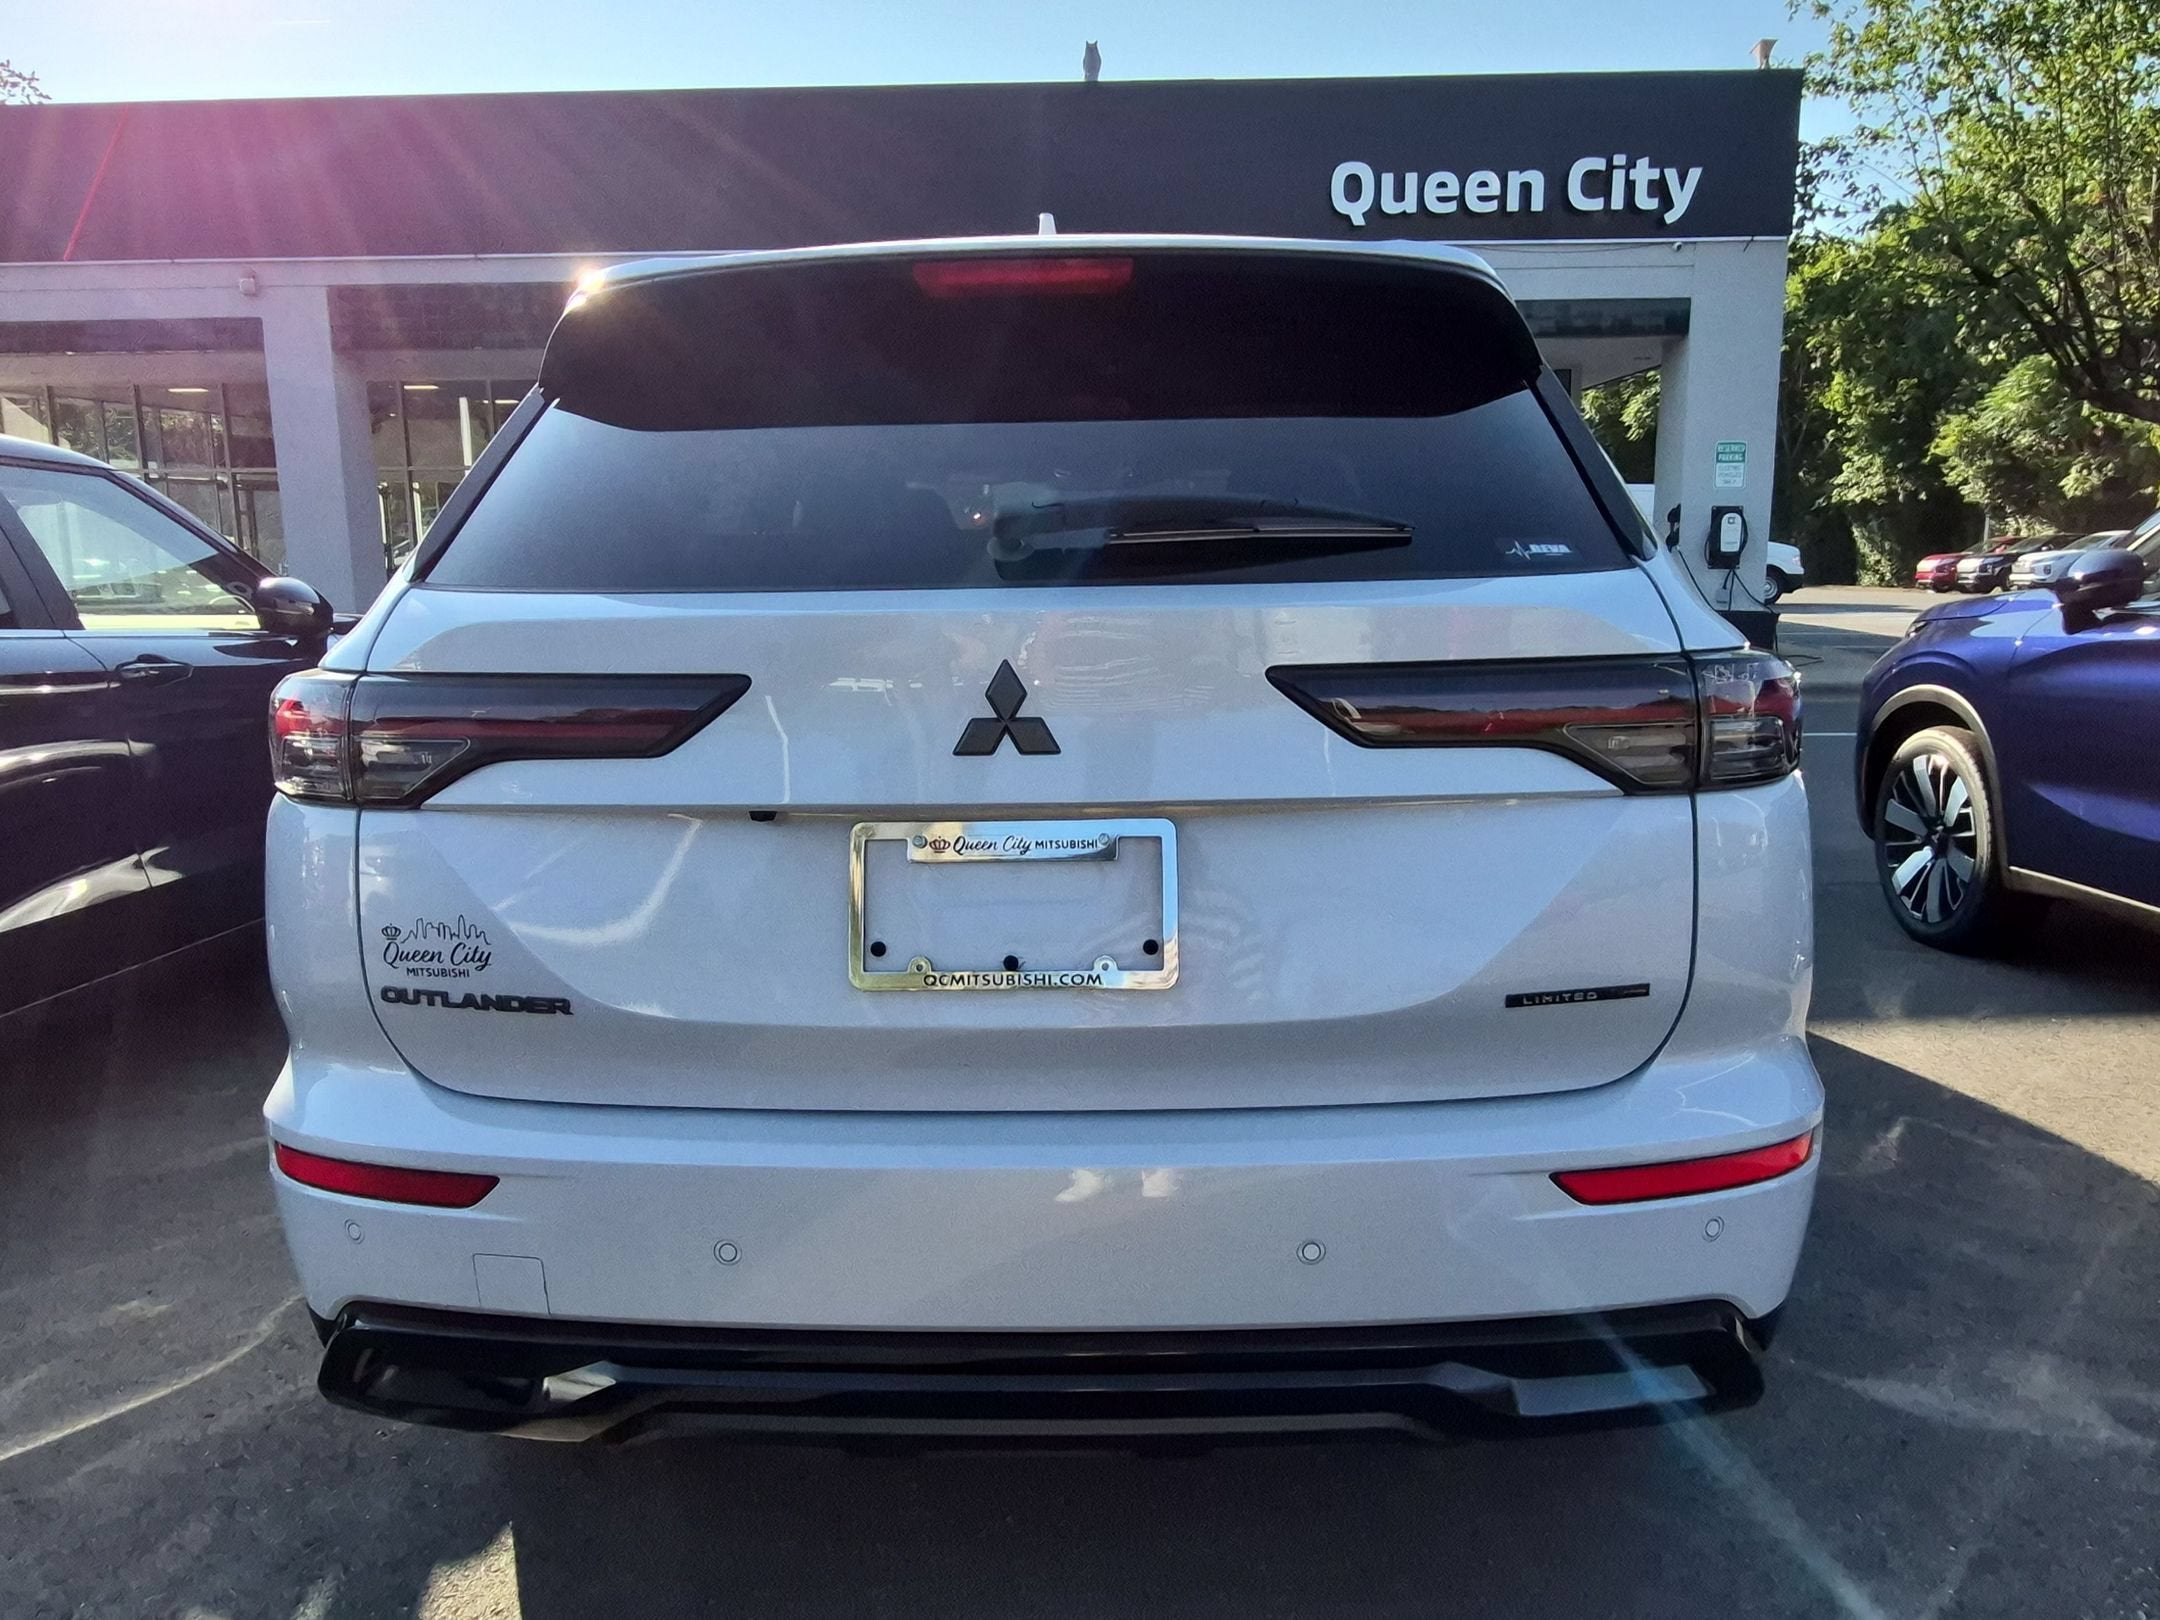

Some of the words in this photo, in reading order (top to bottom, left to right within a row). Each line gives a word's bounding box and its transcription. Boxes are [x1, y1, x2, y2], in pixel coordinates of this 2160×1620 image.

[1330, 160, 1545, 226] Queen
[1567, 154, 1703, 224] City
[953, 836, 998, 855] Queen
[1003, 835, 1032, 855] City
[1035, 839, 1098, 850] MITSUBISHI
[383, 941, 443, 969] Queen
[450, 942, 492, 971] City
[406, 967, 470, 978] MITSUBISHI
[923, 973, 1103, 987] QCMITSUBISHI.COM
[381, 985, 574, 1015] OUTLANDER
[1523, 991, 1598, 1005] LIMITED
